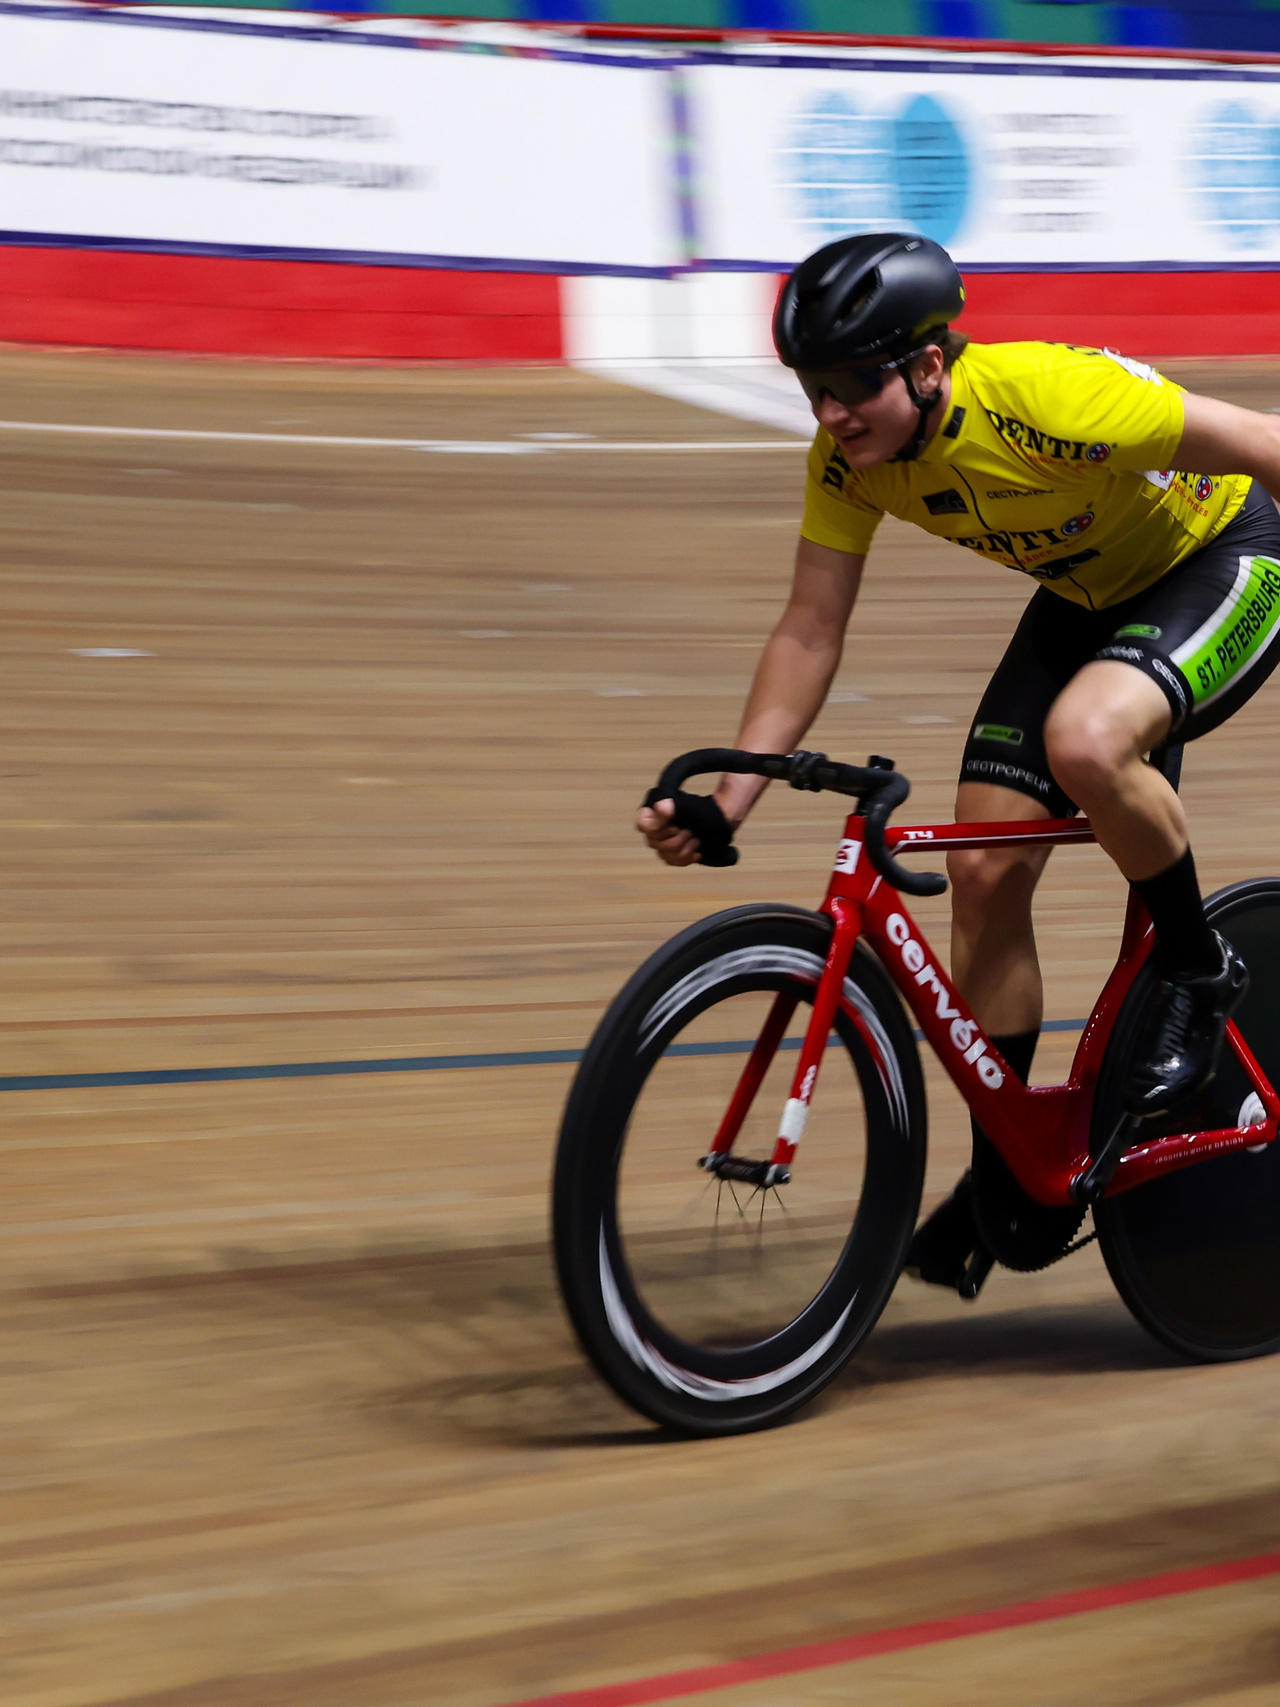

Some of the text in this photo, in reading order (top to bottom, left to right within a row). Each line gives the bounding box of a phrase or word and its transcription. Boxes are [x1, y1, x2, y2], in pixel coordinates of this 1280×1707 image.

[985, 408, 1088, 460] DENTI
[944, 527, 1068, 556] ENTI
[1196, 655, 1224, 691] ST.
